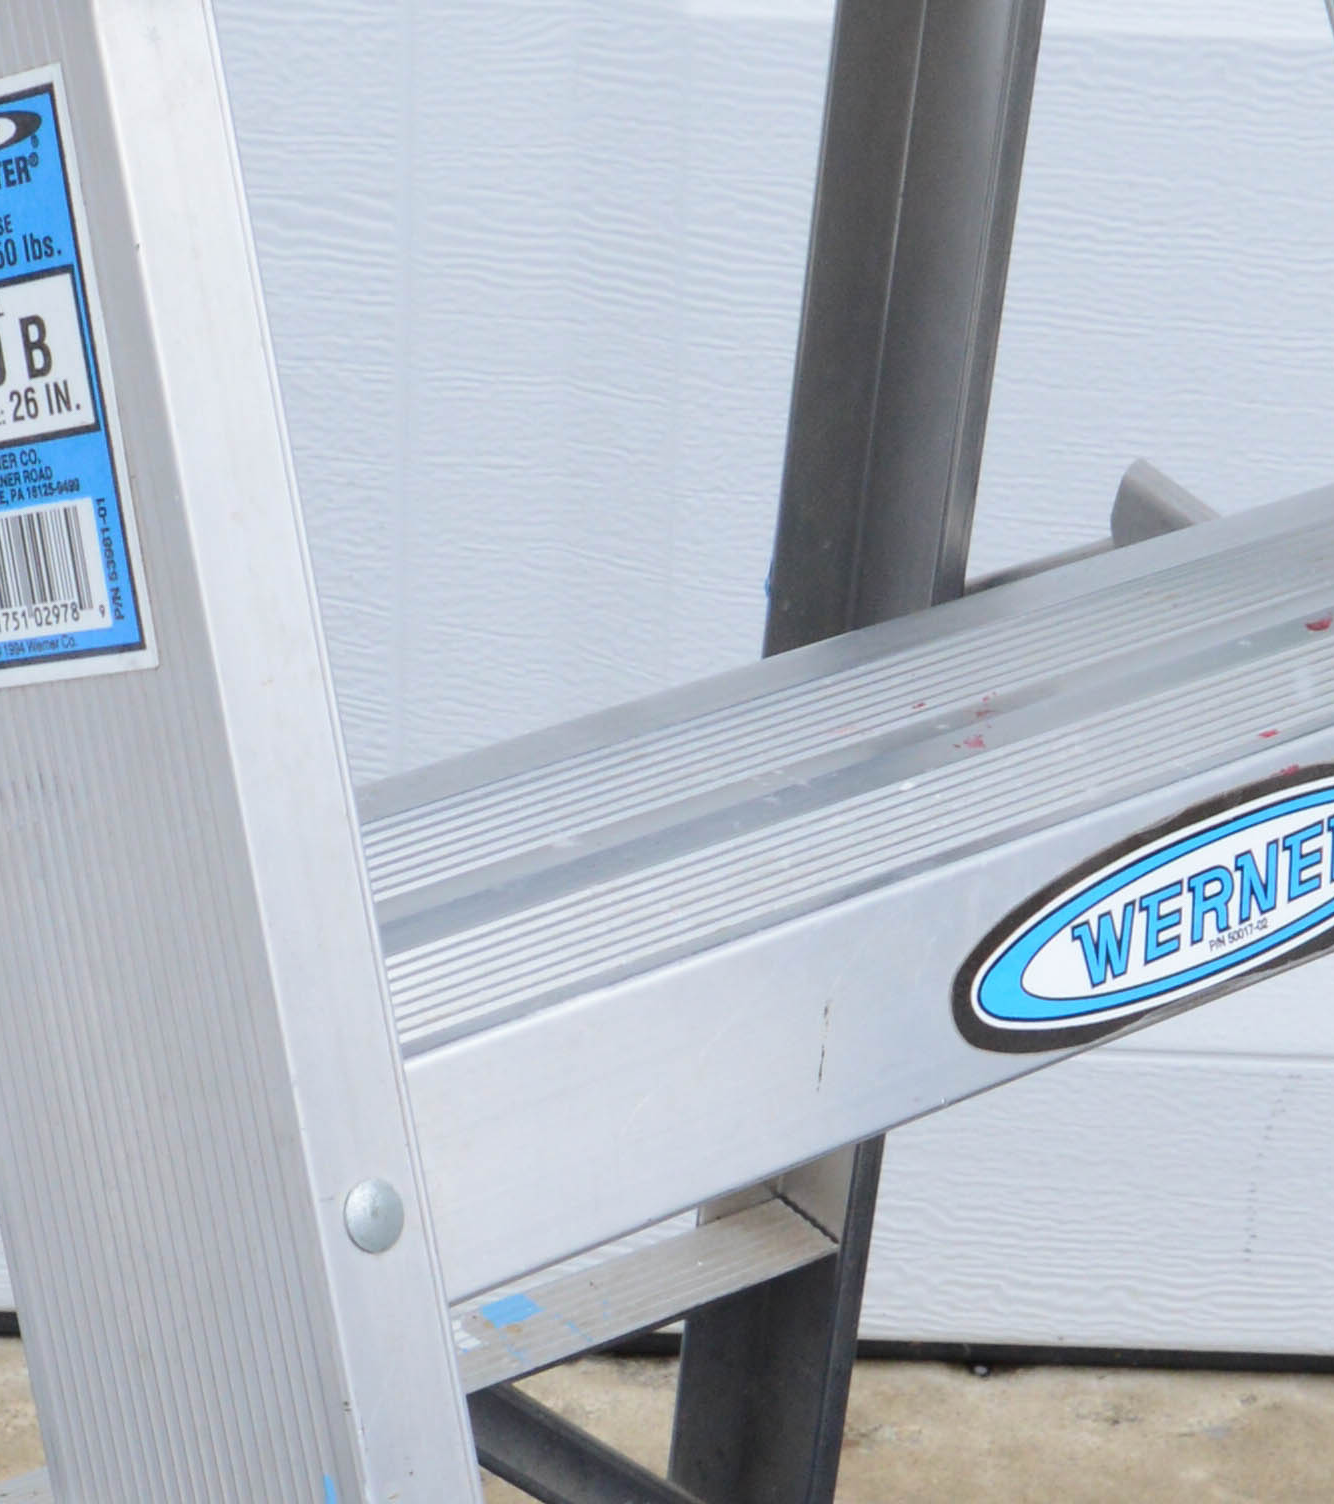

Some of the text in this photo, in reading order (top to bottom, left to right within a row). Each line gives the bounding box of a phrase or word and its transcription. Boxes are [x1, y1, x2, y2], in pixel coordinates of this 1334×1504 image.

[23, 233, 62, 265] lbs.
[20, 314, 53, 380] B
[8, 389, 38, 423] 26
[46, 380, 81, 418] IN.
[19, 448, 41, 467] CO.
[23, 466, 53, 484] ROAD
[11, 488, 25, 503] PA
[34, 602, 80, 628] 02978
[98, 605, 106, 618] 9
[110, 587, 125, 621] P/N
[27, 638, 60, 653] Werner
[1227, 917, 1269, 944] 50017-02
